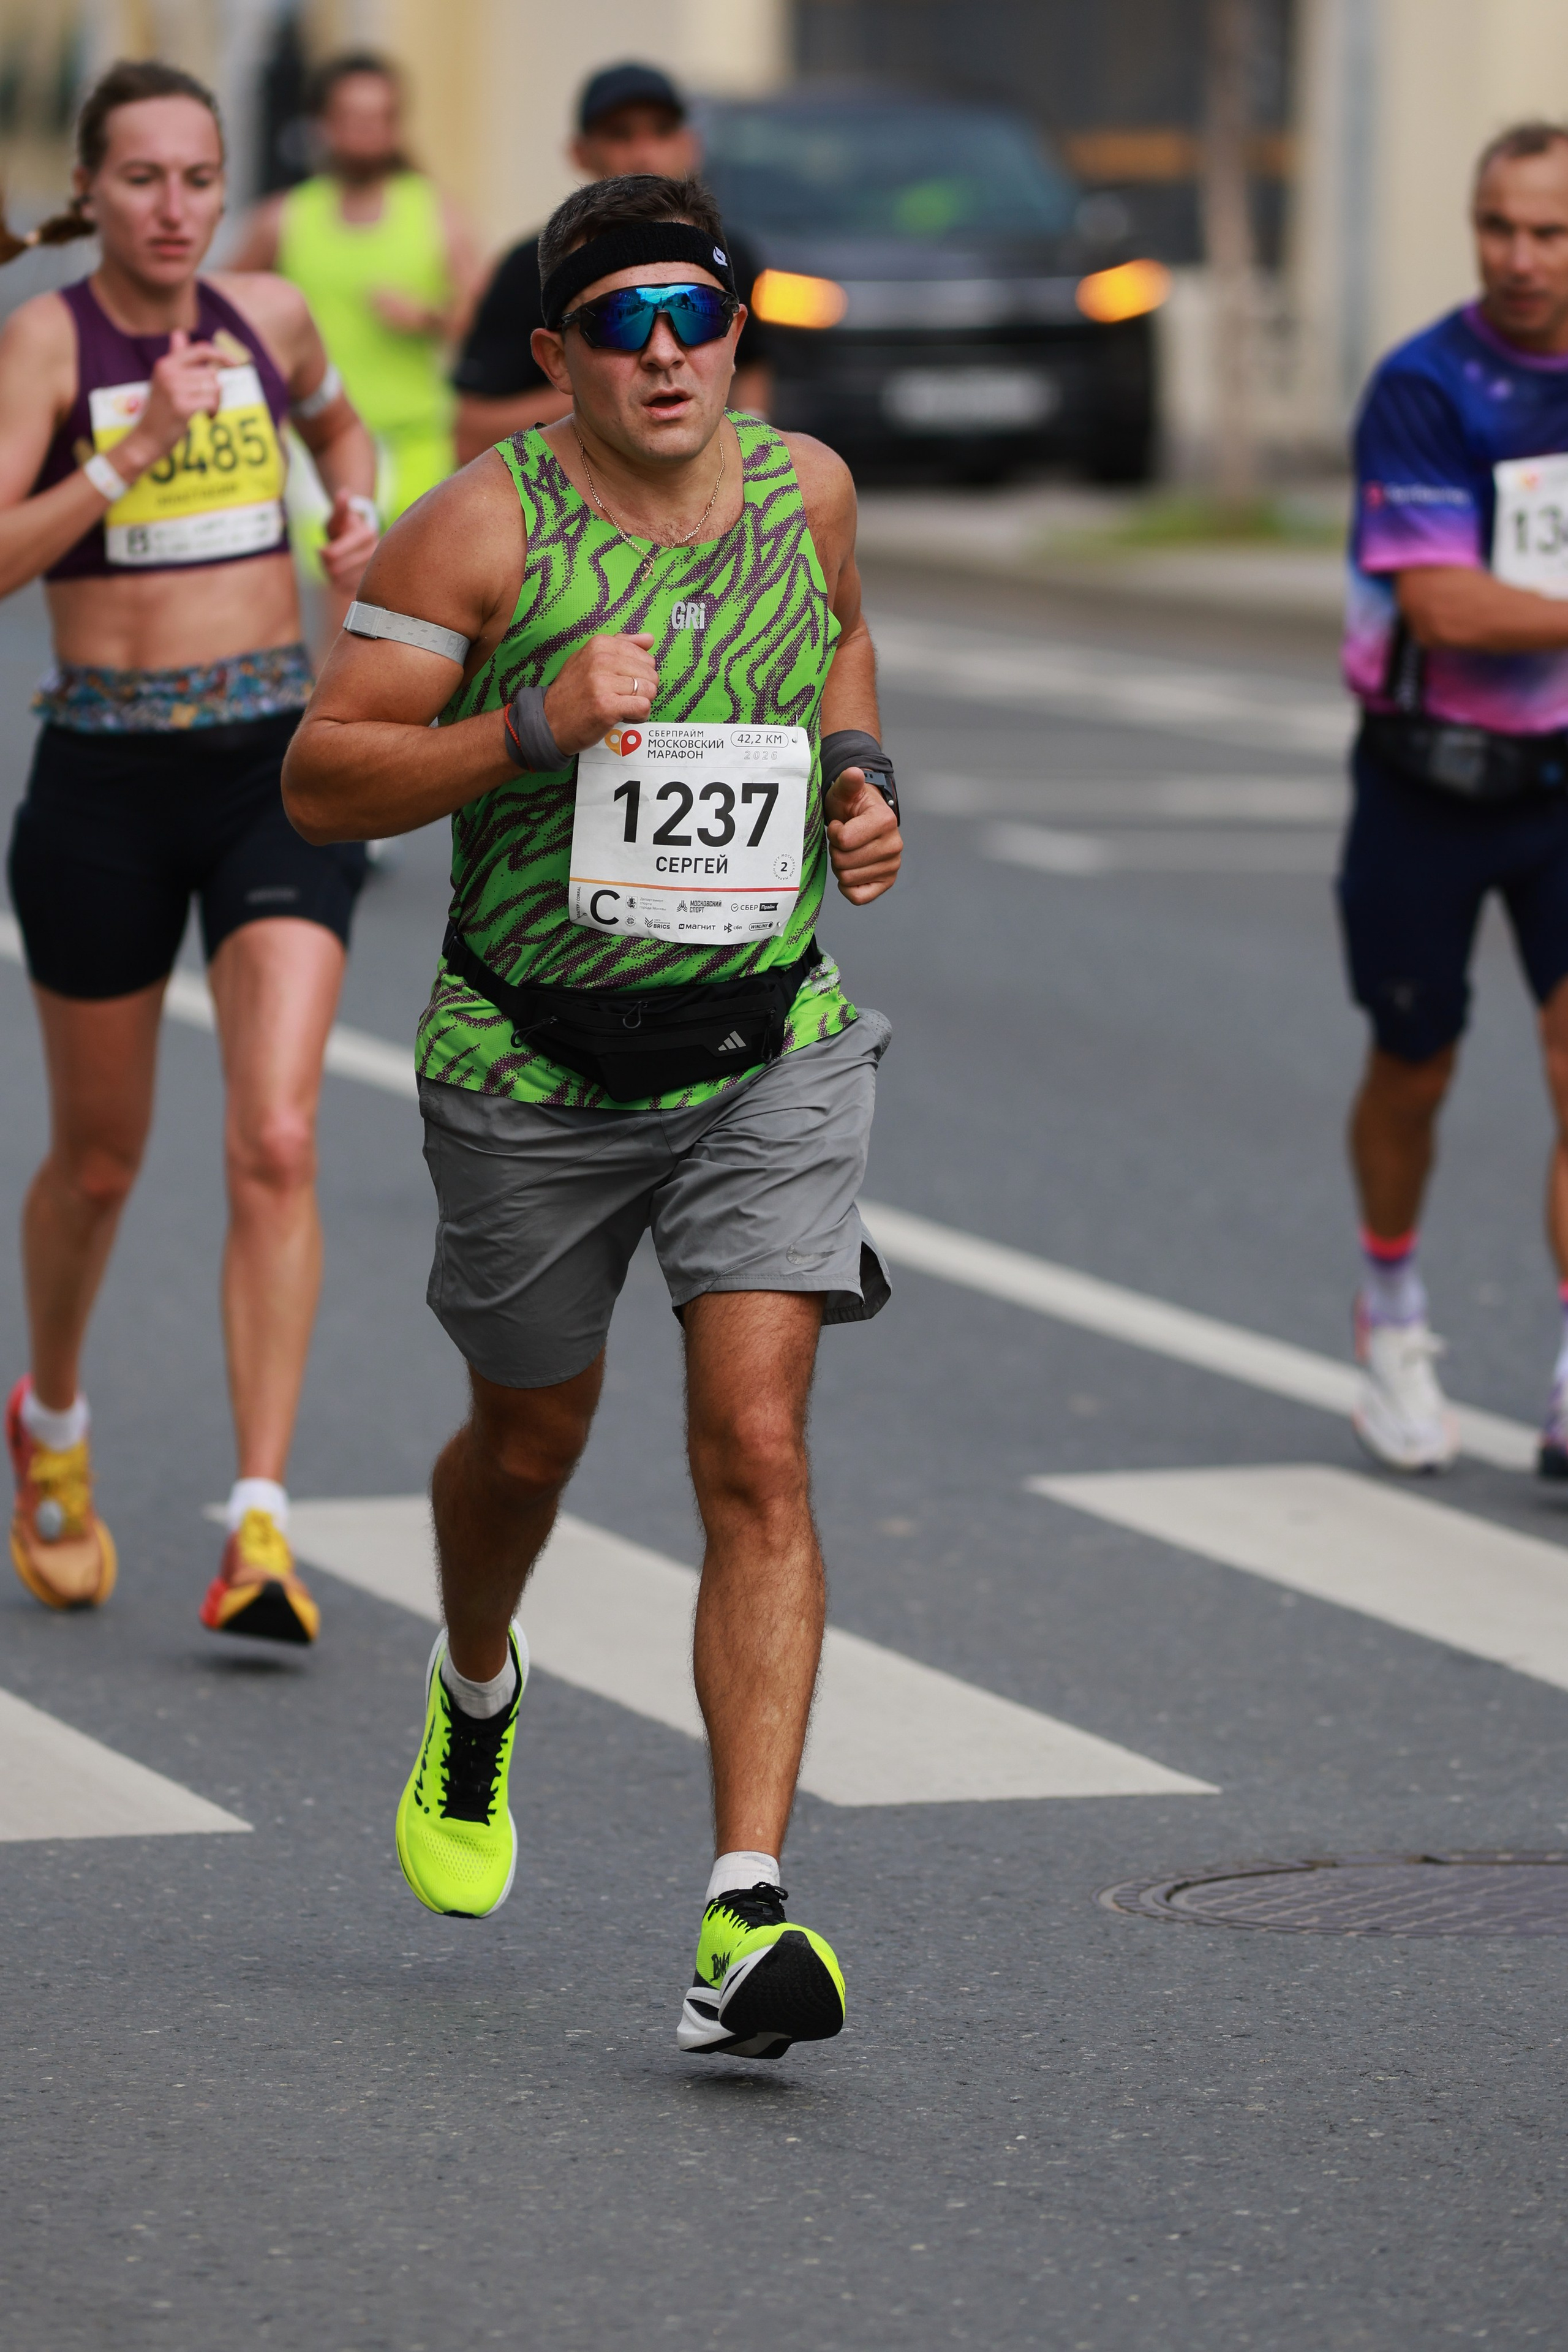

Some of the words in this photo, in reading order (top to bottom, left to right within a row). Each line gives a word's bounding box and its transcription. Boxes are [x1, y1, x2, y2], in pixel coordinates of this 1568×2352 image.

[1516, 505, 1568, 555] 13
[648, 738, 724, 748] МОСКОВСКИЙ
[737, 734, 761, 745] 42,2
[766, 734, 782, 744] КМ
[647, 750, 703, 759] МАРАФОН
[744, 750, 778, 760] 2026
[613, 780, 779, 847] 1237
[655, 854, 728, 874] СЕРГЕЙ
[780, 861, 788, 872] 2
[590, 889, 620, 925] C
